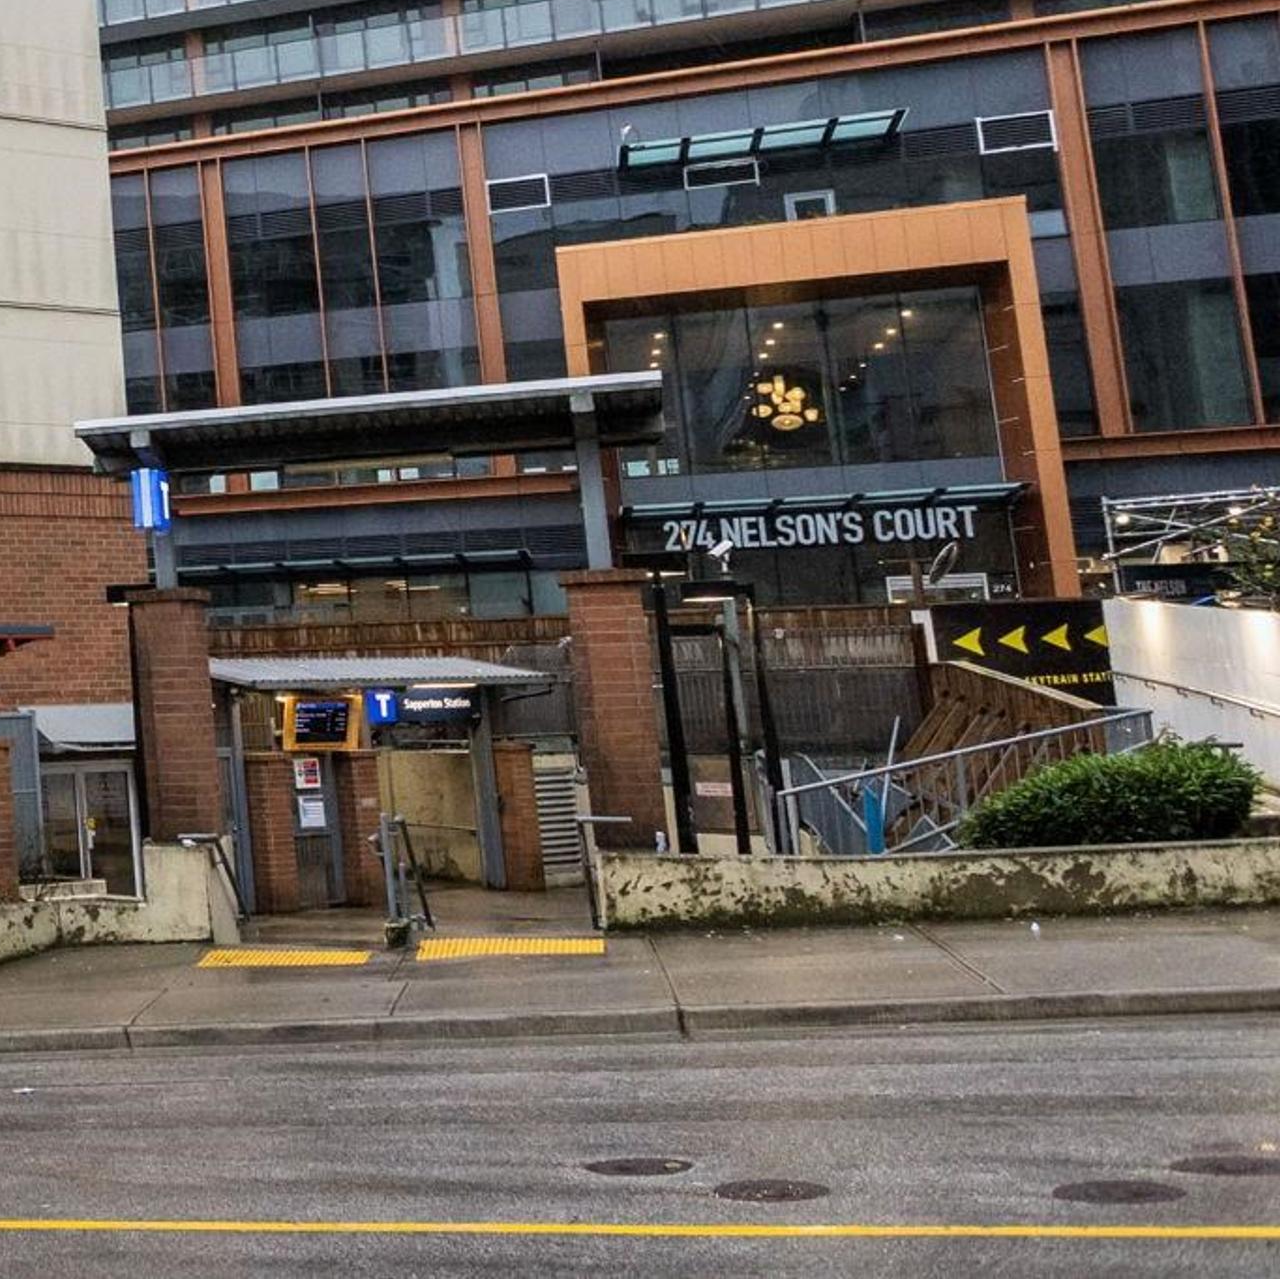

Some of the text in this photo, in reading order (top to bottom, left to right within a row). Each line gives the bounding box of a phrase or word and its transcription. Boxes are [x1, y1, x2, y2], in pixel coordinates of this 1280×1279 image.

[663, 505, 978, 552] 274 NELSON'S COURT
[991, 583, 1012, 594] 274
[1024, 673, 1079, 686] SKYTRAIN
[374, 693, 391, 718] T
[403, 697, 472, 712] Sapperton Station
